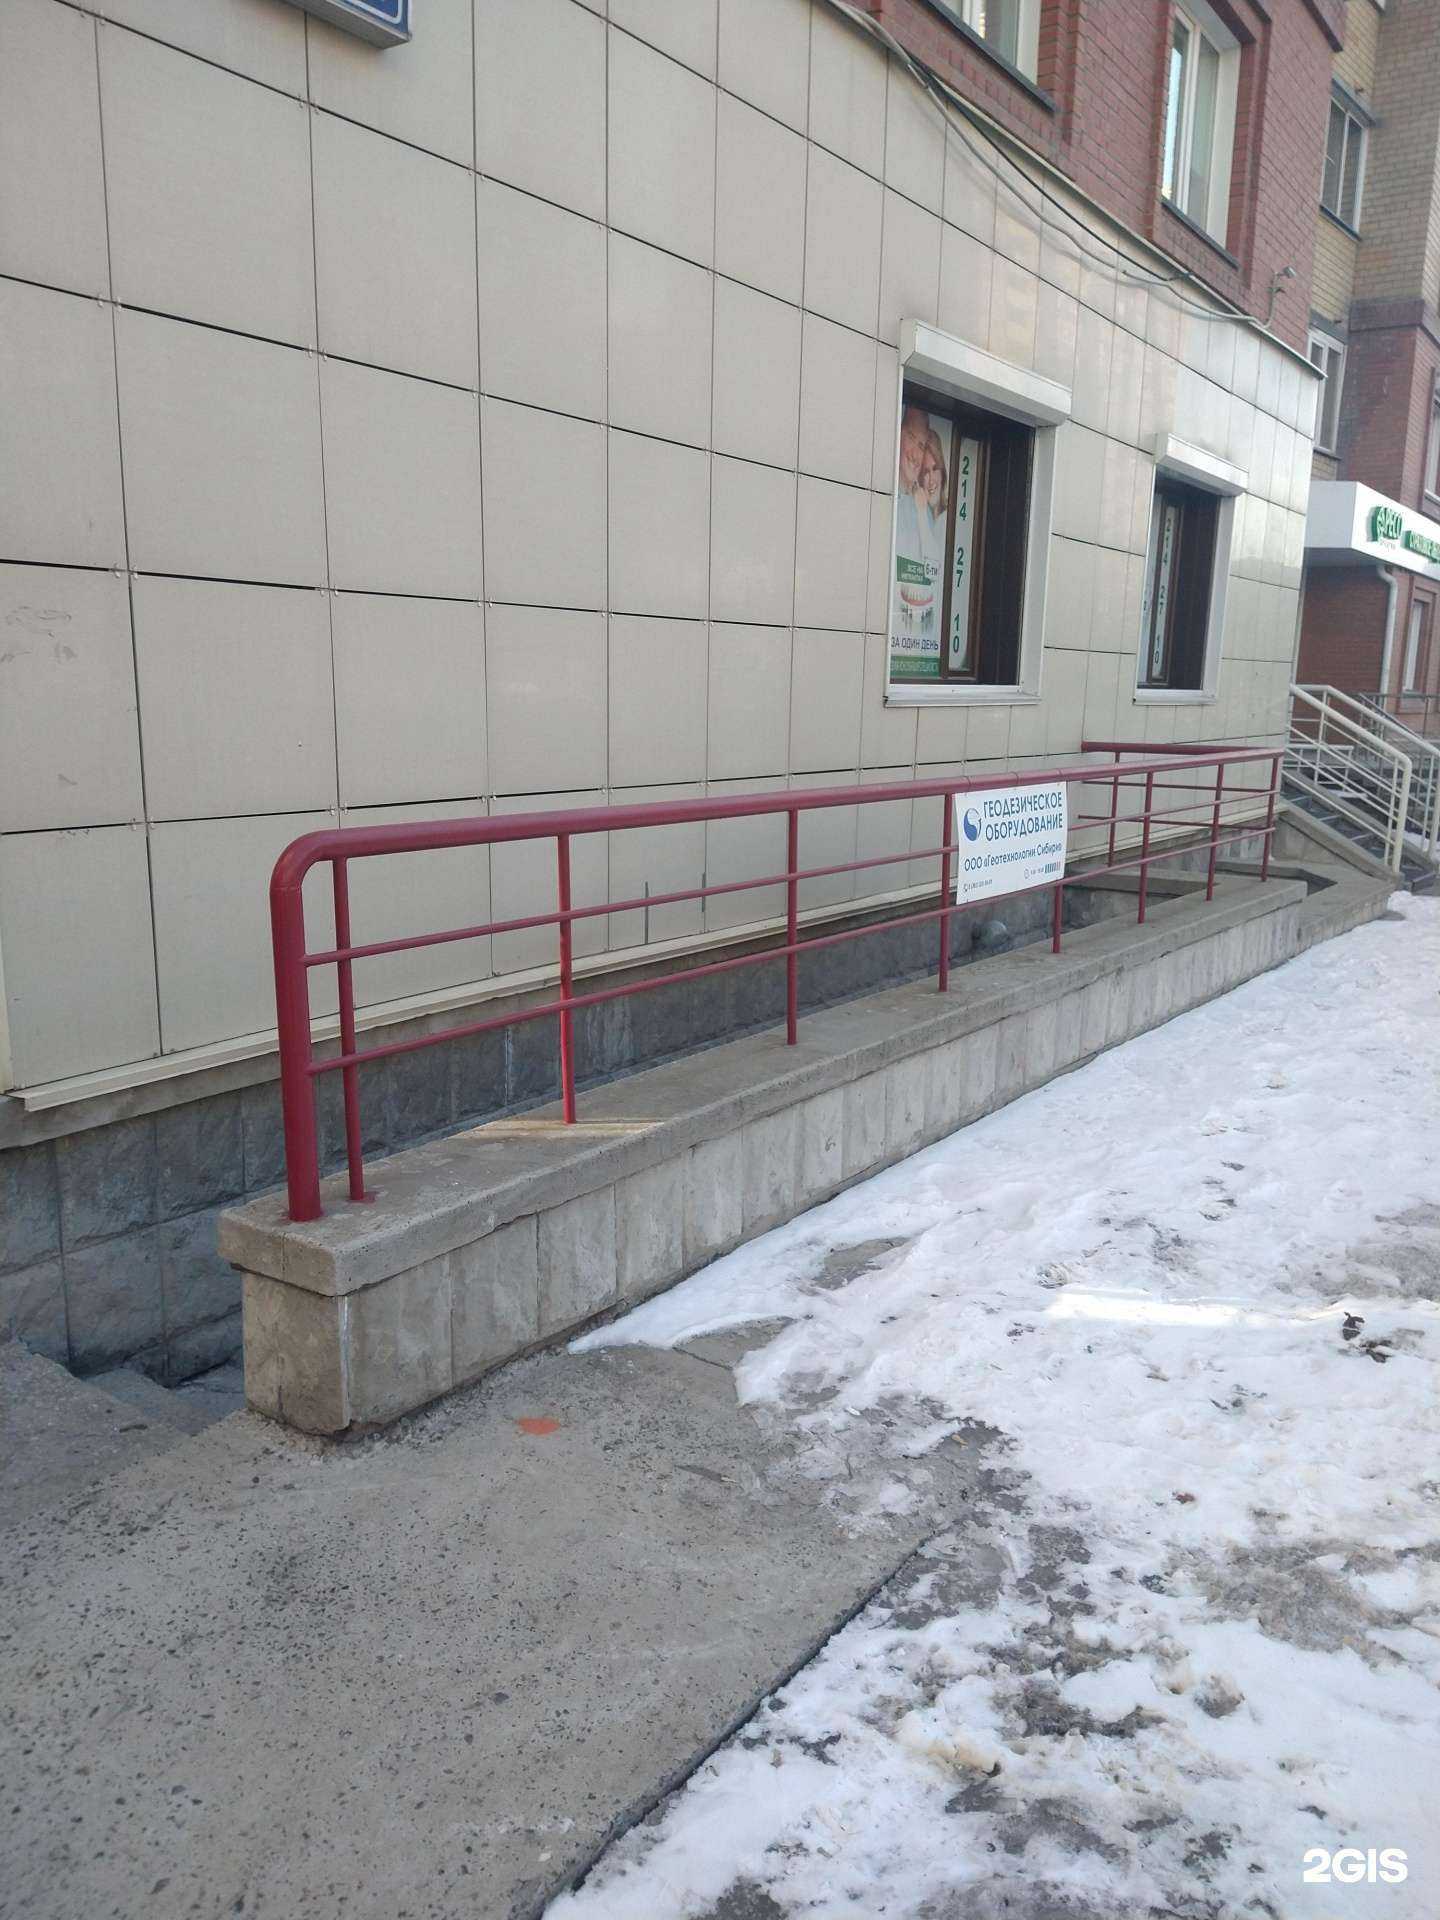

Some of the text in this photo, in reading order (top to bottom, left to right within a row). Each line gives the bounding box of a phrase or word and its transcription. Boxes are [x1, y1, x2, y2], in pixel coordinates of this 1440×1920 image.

[891, 636, 939, 650] ЗА ОДИН ДЕНЬ
[983, 791, 1062, 819] ГЕОДЕЗИЧЕСКОЕ
[985, 813, 1063, 842] ОБОРУДОВАНИЕ
[964, 856, 983, 872] ООО
